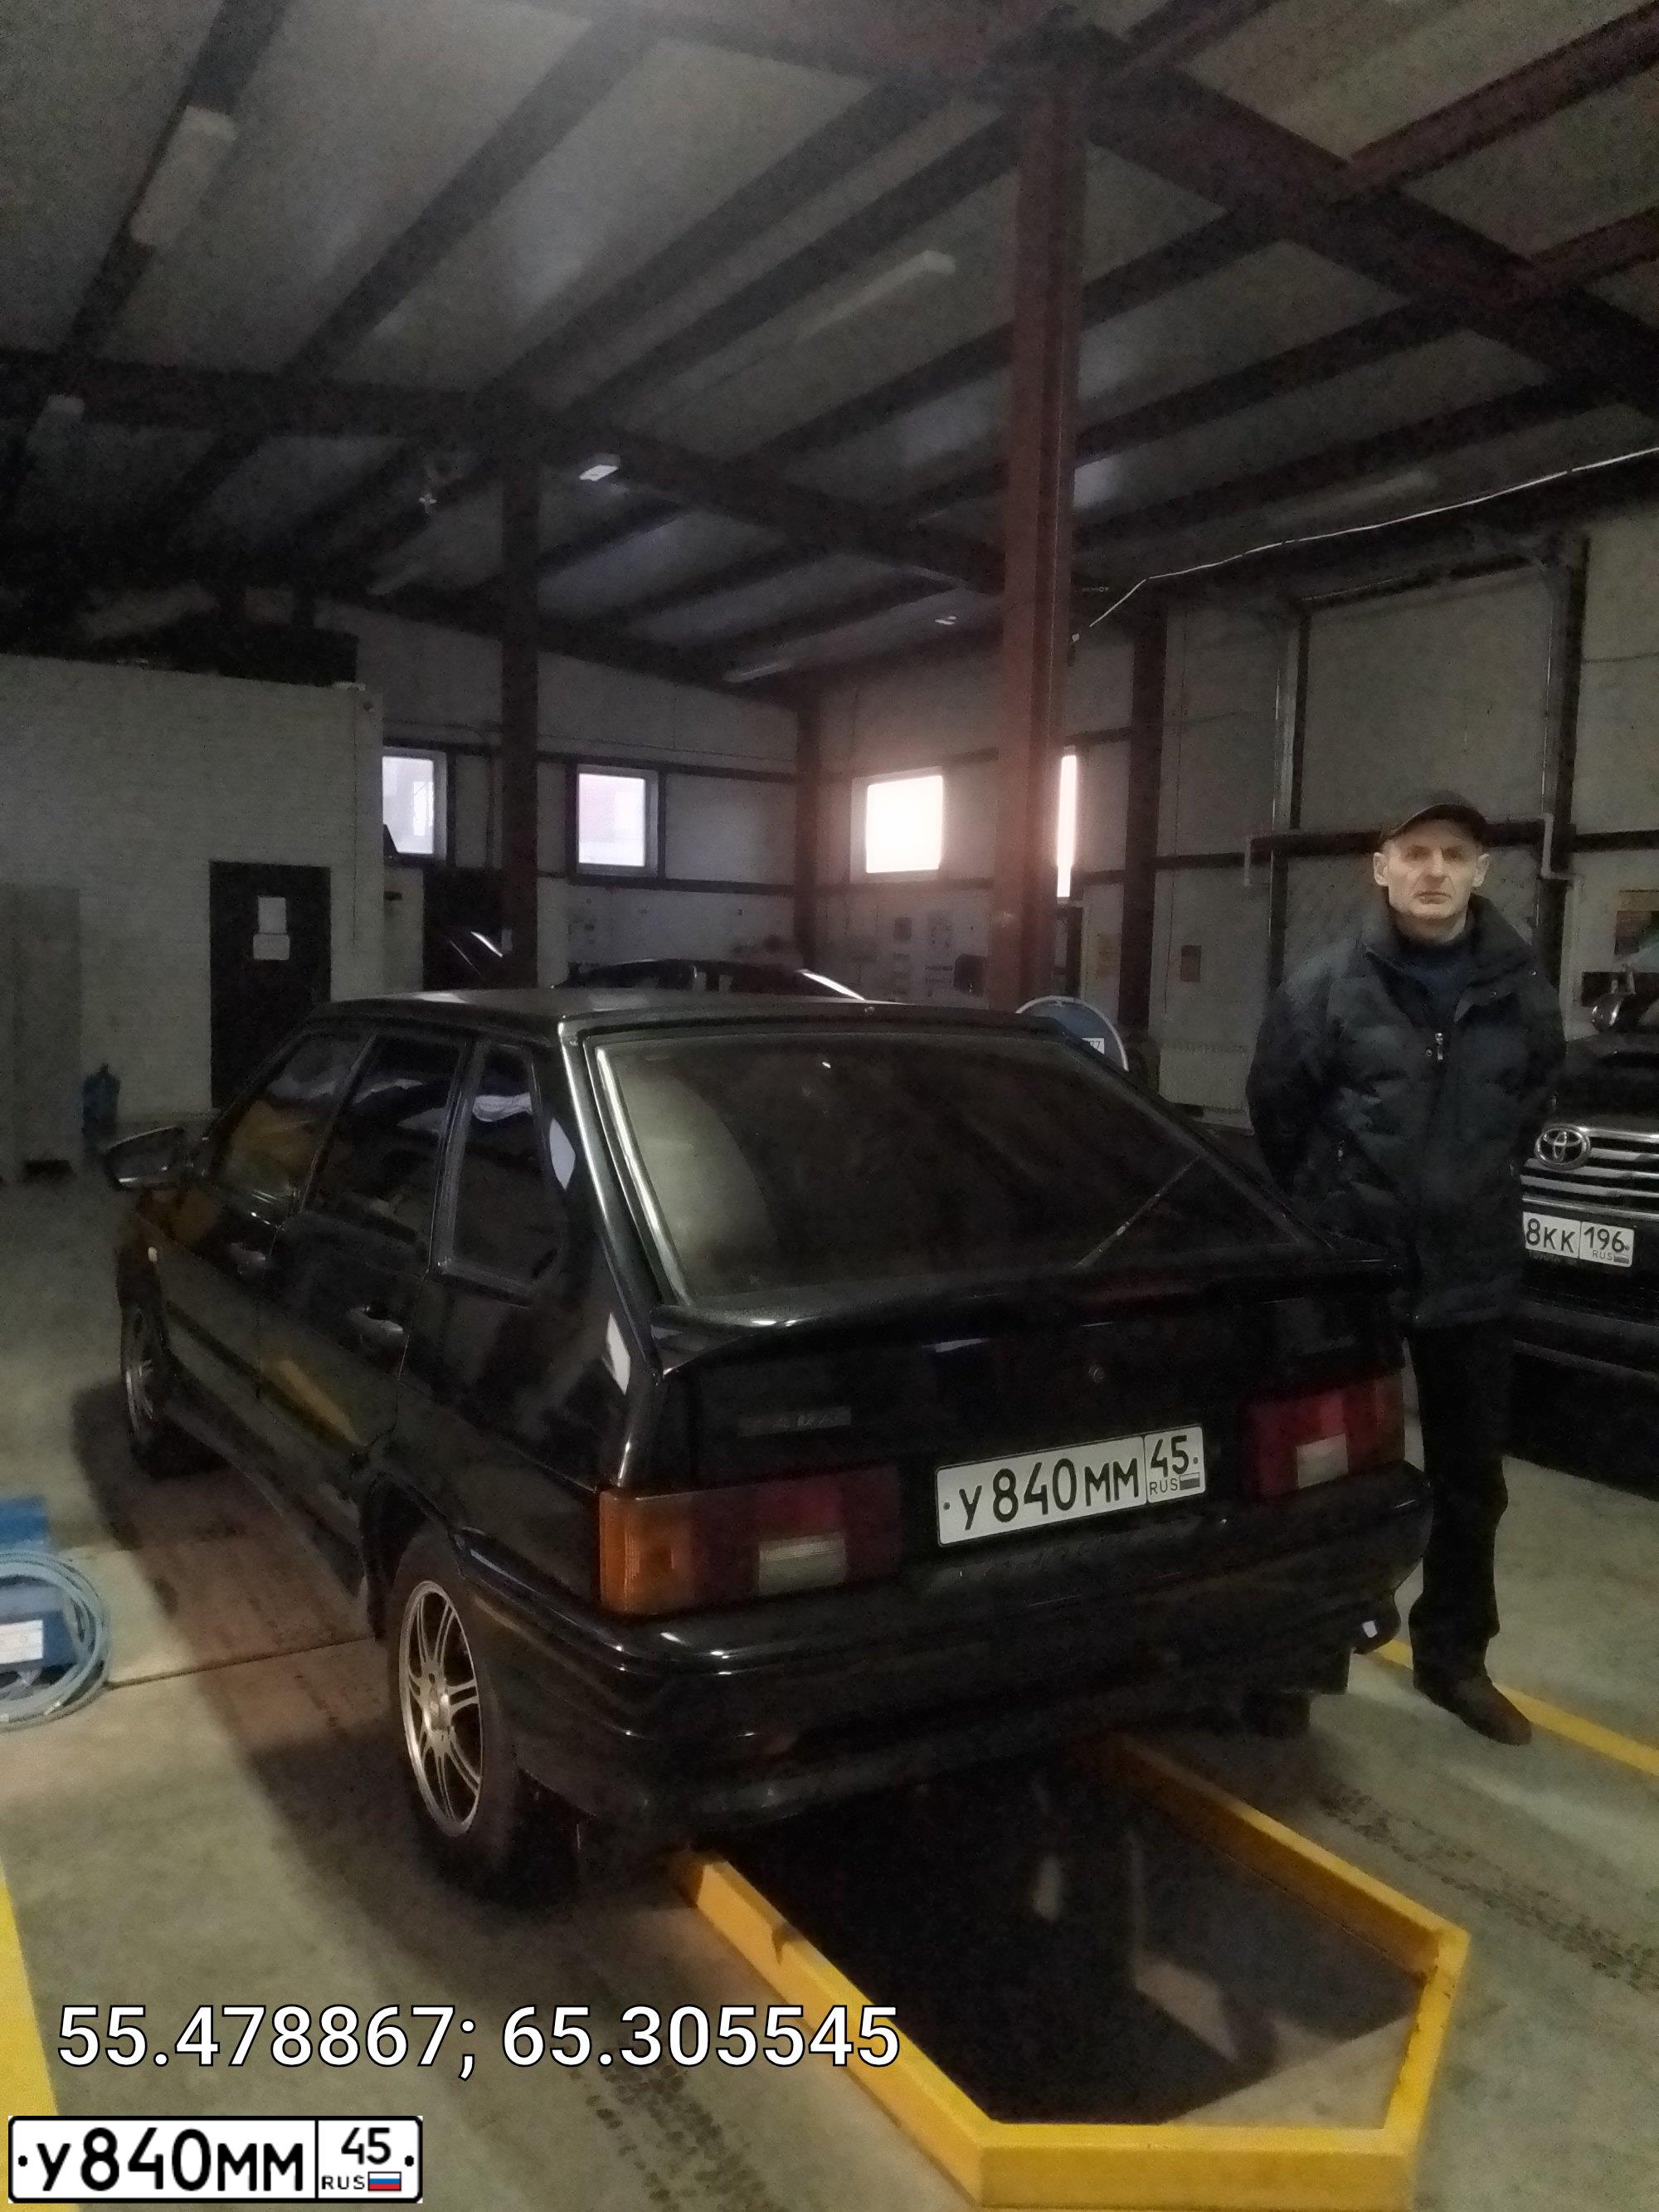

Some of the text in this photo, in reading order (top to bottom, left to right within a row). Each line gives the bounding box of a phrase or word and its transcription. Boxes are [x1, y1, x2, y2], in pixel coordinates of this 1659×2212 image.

[1584, 1226, 1625, 1254] 196
[1592, 1250, 1613, 1261] RUS
[1150, 1435, 1189, 1477] 45
[1149, 1478, 1179, 1495] RUS
